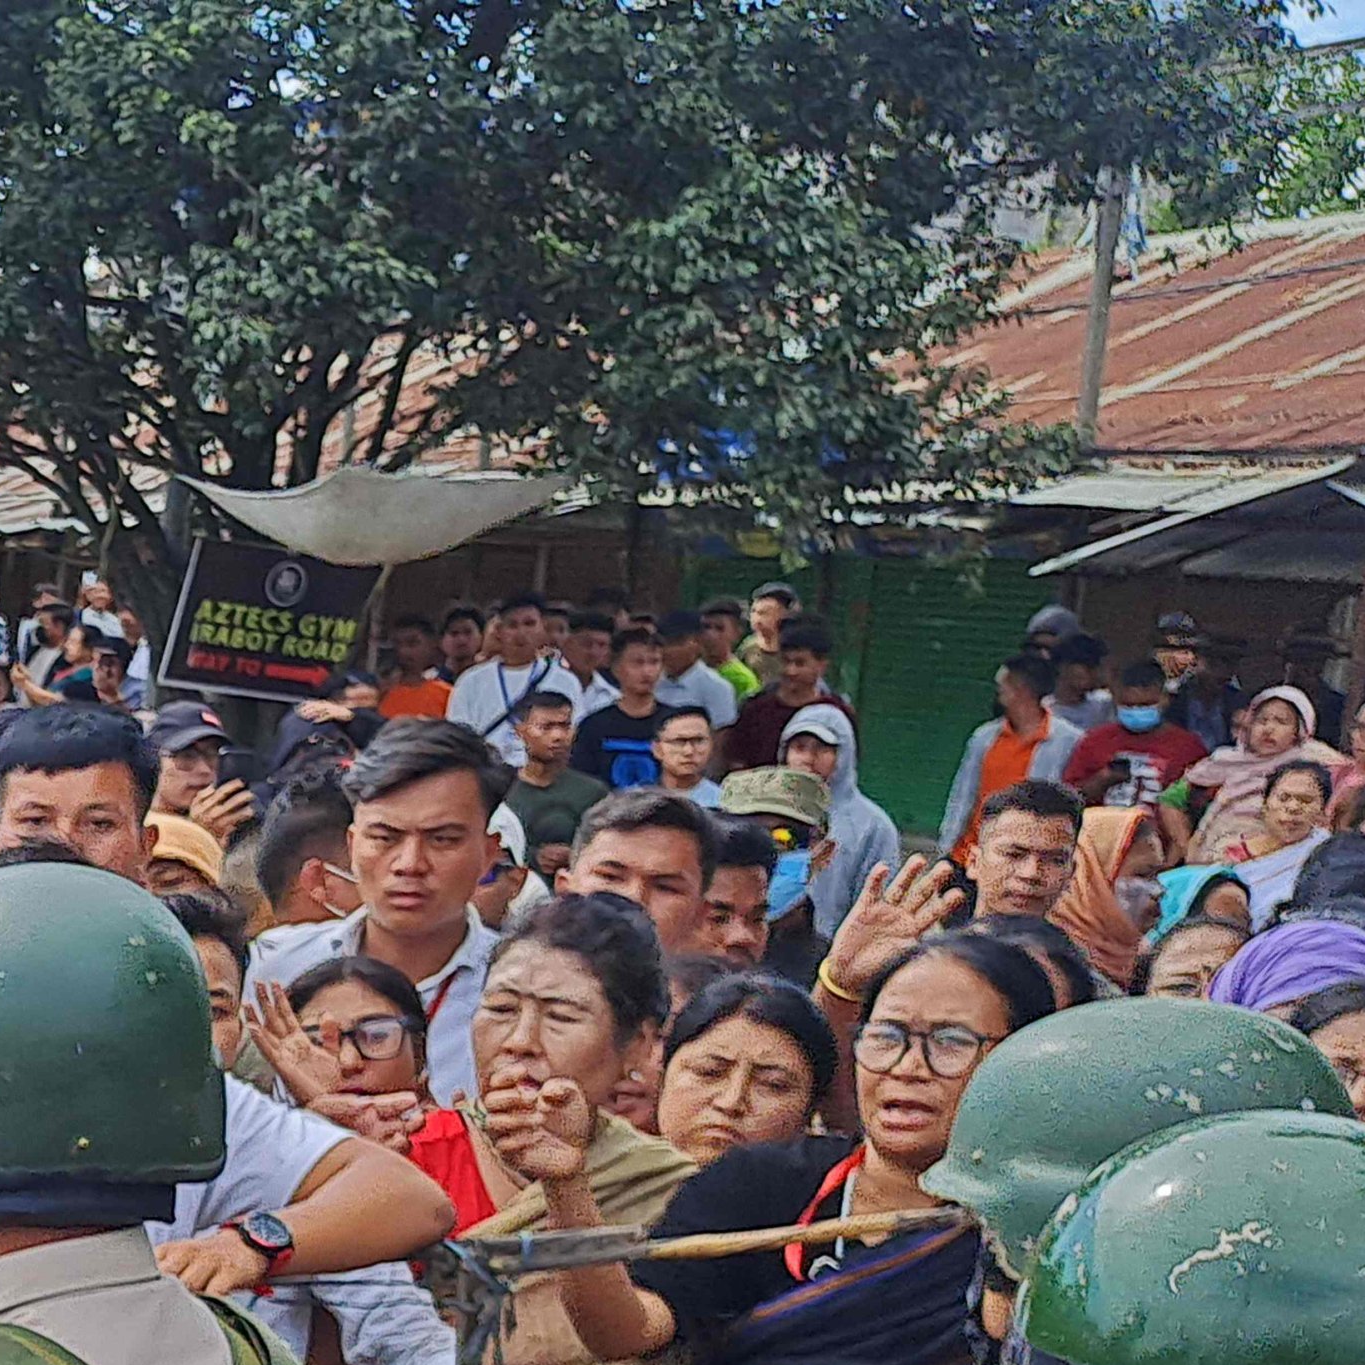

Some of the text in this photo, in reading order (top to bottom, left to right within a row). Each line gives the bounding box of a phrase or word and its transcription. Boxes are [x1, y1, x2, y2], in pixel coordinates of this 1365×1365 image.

[194, 599, 358, 643] AZTECS GYM
[281, 634, 349, 663] ROAD
